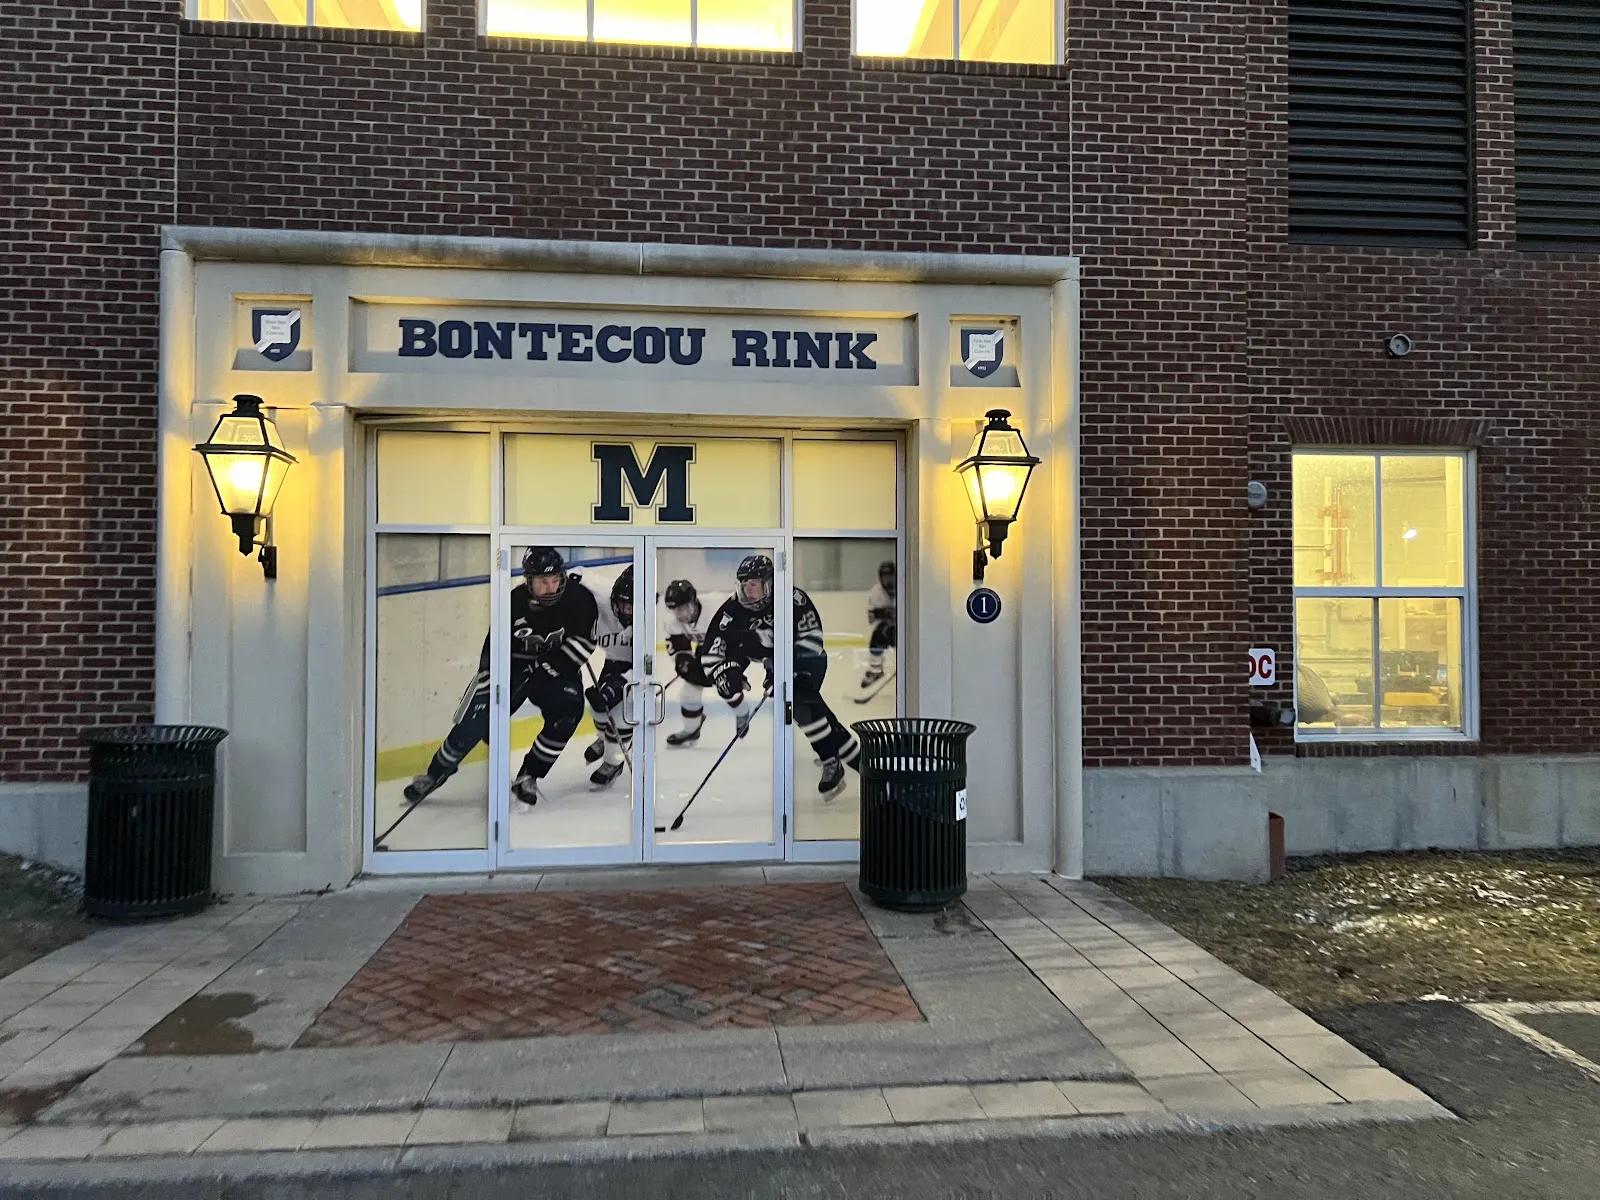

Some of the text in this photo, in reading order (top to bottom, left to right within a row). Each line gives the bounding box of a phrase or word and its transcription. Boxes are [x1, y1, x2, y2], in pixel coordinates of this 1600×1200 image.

[398, 319, 878, 370] BONTECOU RINK
[590, 440, 697, 525] M
[797, 610, 818, 631] 22
[980, 596, 988, 614] 1
